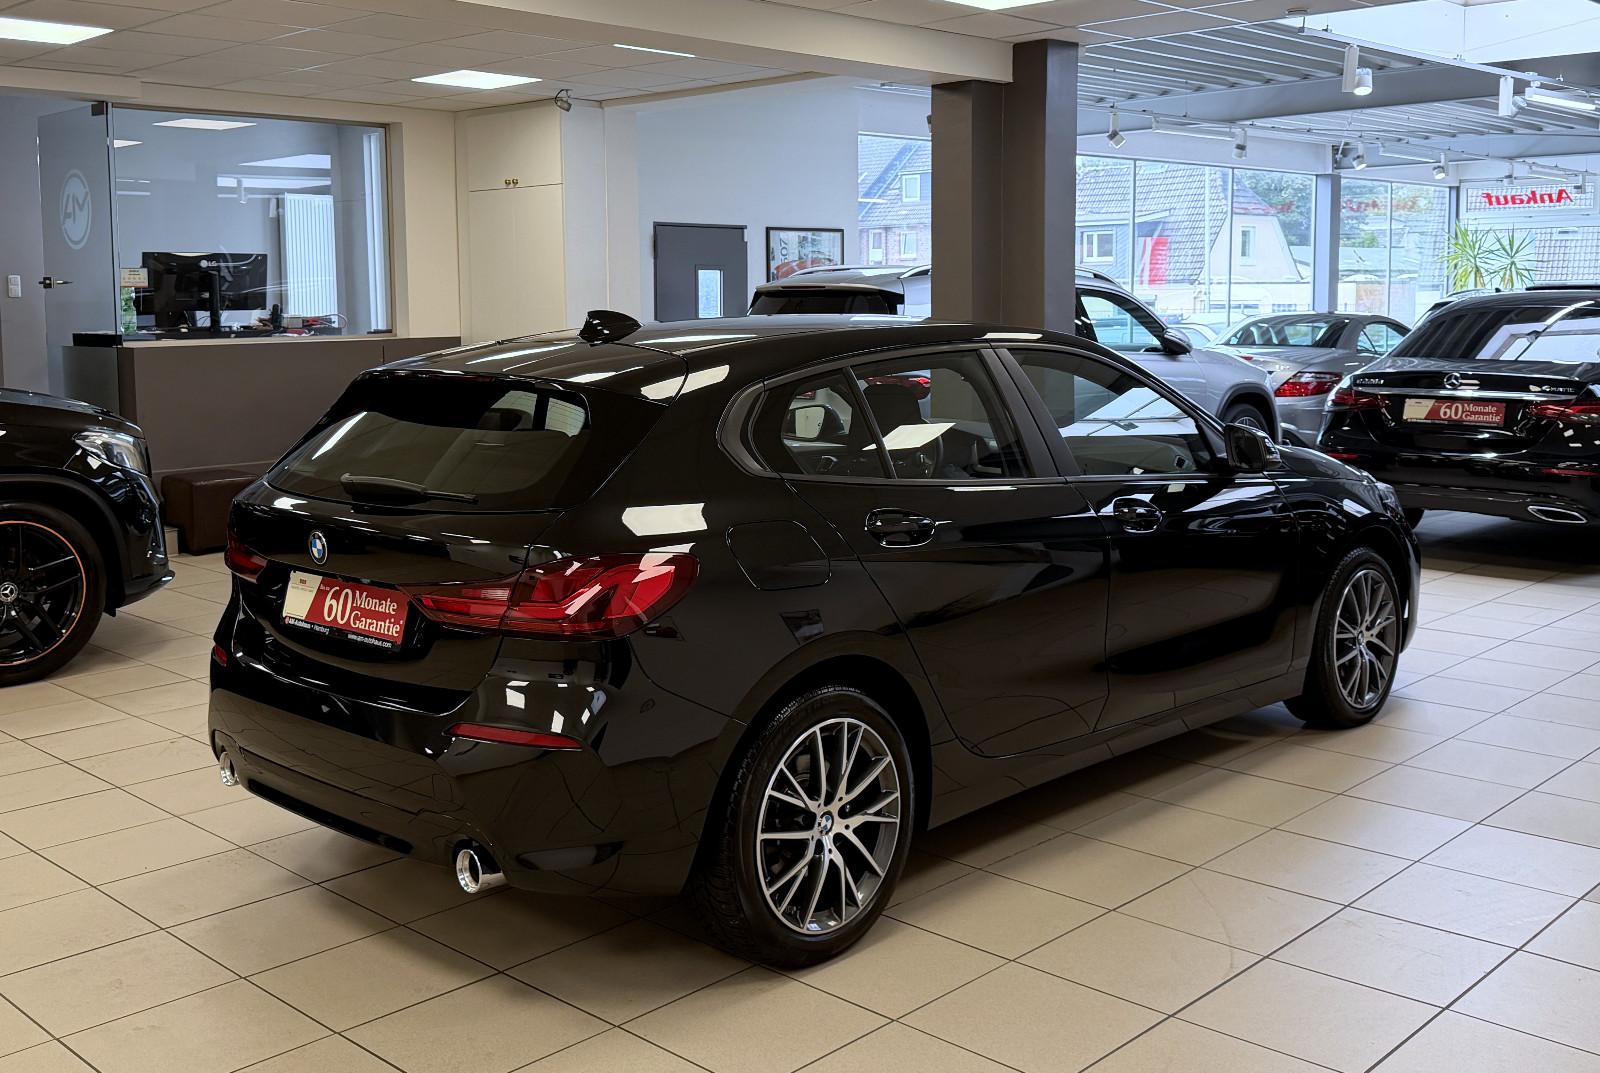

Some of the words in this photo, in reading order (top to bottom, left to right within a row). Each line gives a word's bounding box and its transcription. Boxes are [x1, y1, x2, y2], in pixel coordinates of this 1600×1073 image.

[1440, 403, 1462, 419] 60
[1463, 403, 1497, 413] Monate
[323, 586, 352, 625] 60
[353, 590, 398, 615] Monate
